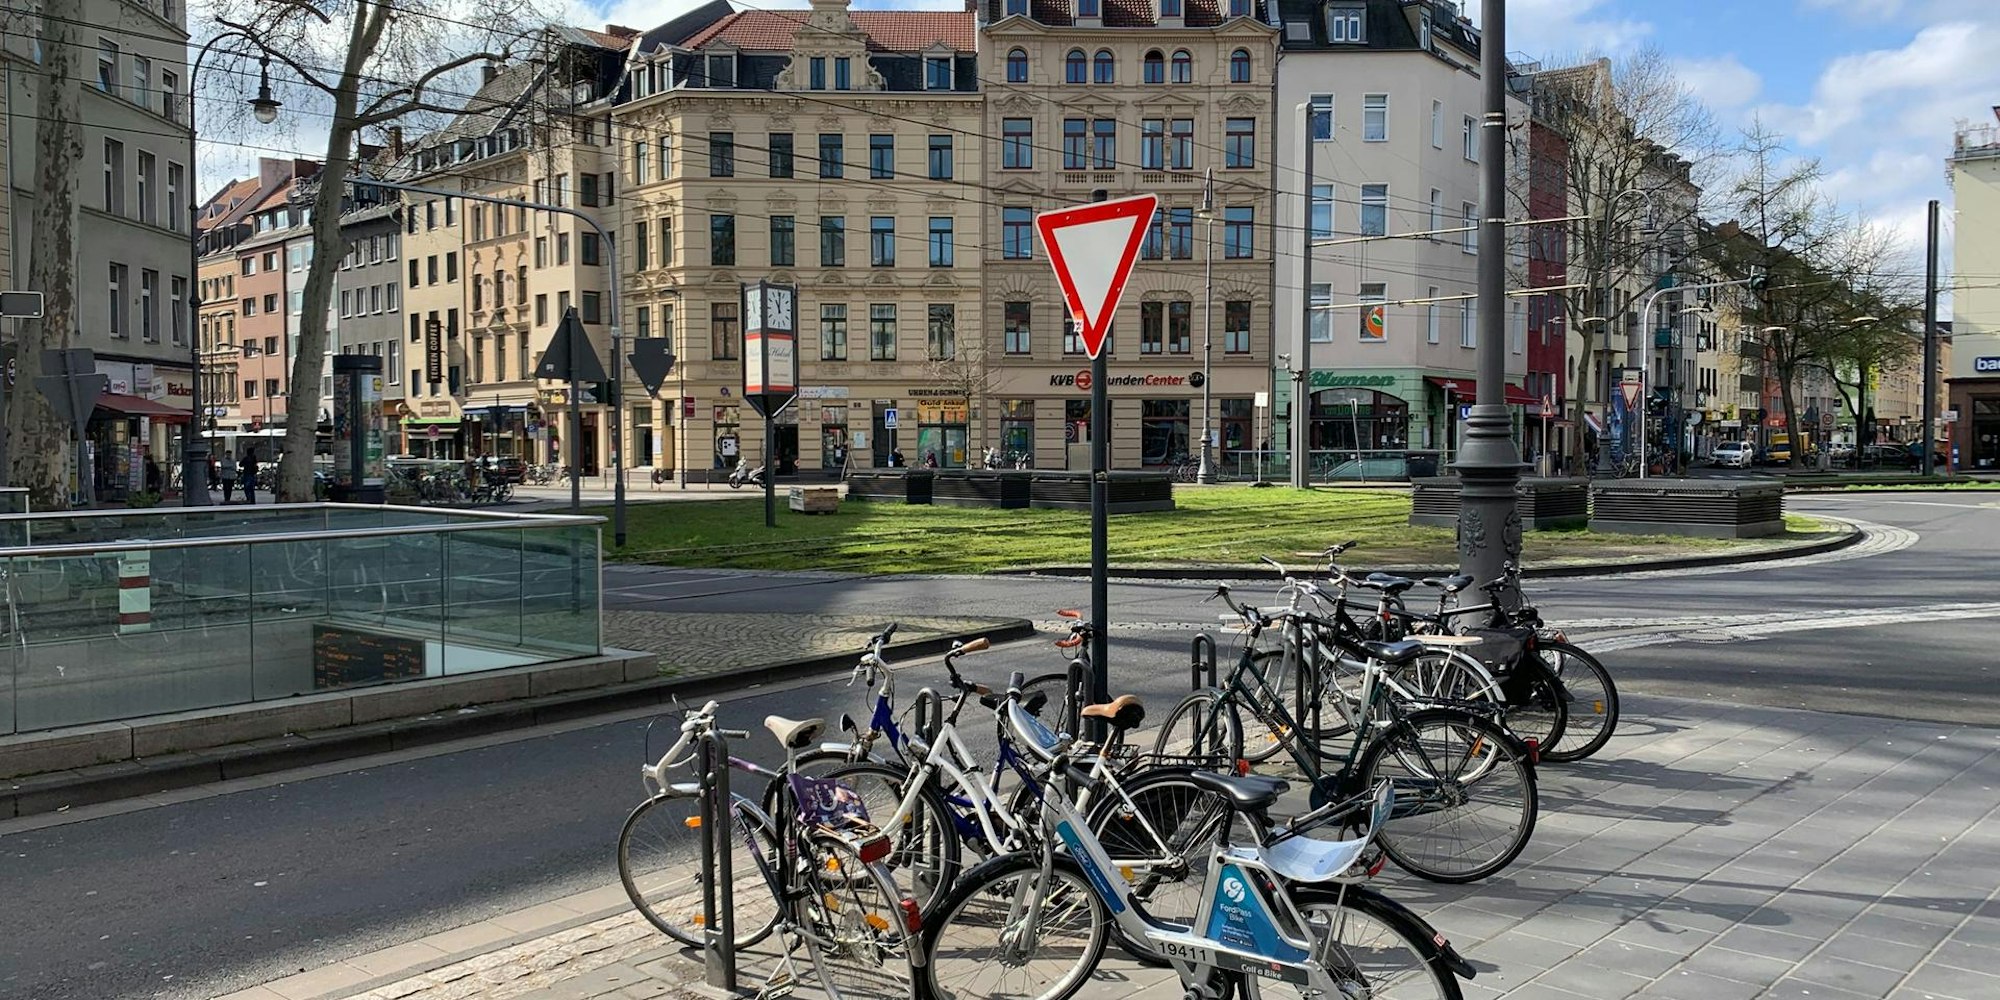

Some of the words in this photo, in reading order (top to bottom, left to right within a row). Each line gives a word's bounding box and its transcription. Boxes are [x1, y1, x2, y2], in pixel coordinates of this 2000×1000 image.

[430, 323, 438, 351] COFFEE
[1050, 375, 1074, 386] KVB
[1107, 375, 1185, 386] undenCenter
[1220, 903, 1252, 917] FordPass
[1229, 914, 1244, 923] Bike
[1159, 942, 1206, 961] 19411
[1241, 963, 1257, 973] Call
[1264, 969, 1282, 980] Bike
